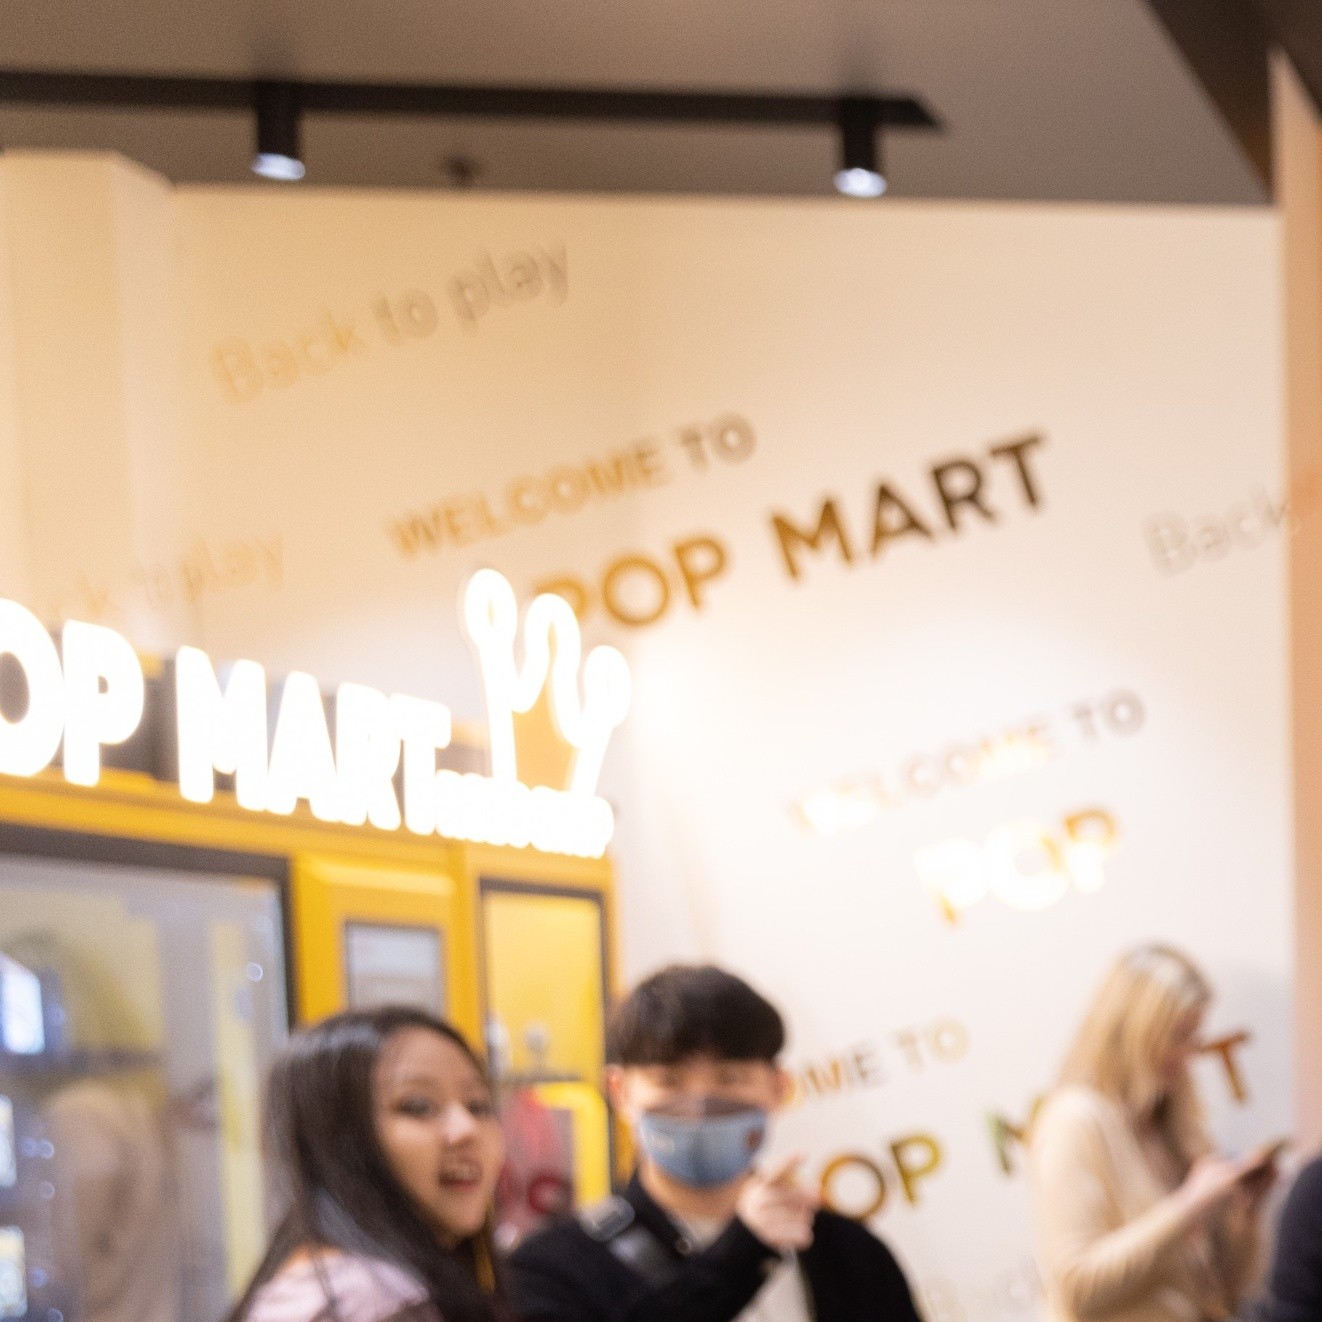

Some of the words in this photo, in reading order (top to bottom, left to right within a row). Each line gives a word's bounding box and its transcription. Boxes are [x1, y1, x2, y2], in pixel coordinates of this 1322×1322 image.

[208, 309, 366, 404] Back
[448, 242, 571, 330] play
[387, 437, 672, 560] WELCOME
[681, 412, 757, 466] TO
[769, 428, 1050, 584] MART
[0, 598, 145, 787] OP
[176, 644, 452, 836] MART
[1065, 686, 1149, 746] TO
[817, 1130, 943, 1224] OP
